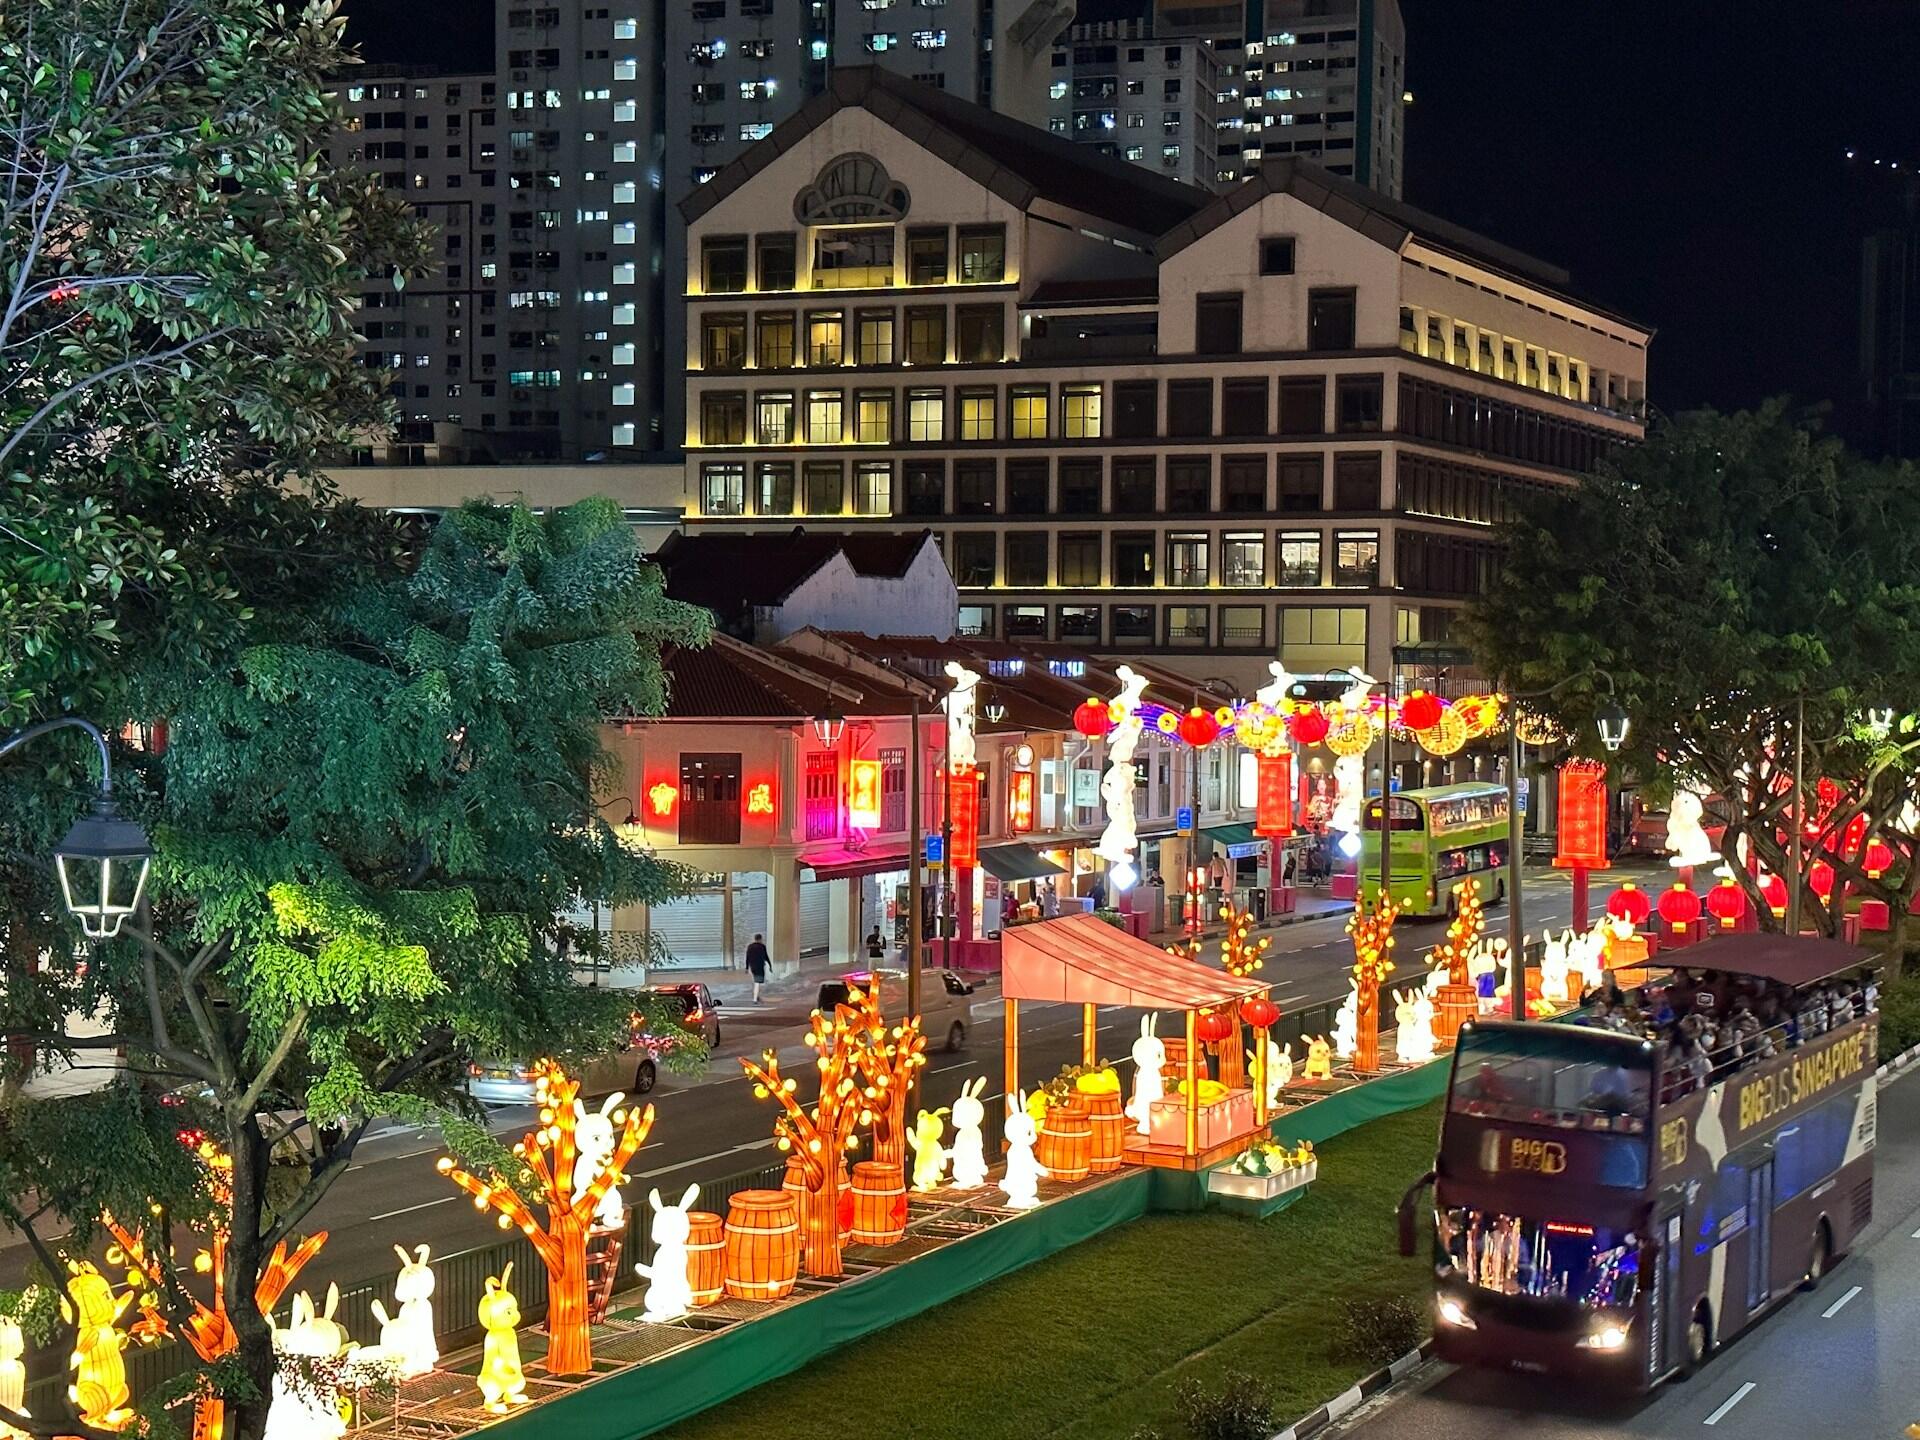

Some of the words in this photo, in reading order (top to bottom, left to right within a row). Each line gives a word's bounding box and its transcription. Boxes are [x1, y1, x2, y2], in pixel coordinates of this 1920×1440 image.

[1430, 721, 1451, 743] 事
[1791, 1030, 1865, 1104] SINGAPORE
[1513, 1138, 1543, 1155] BIG
